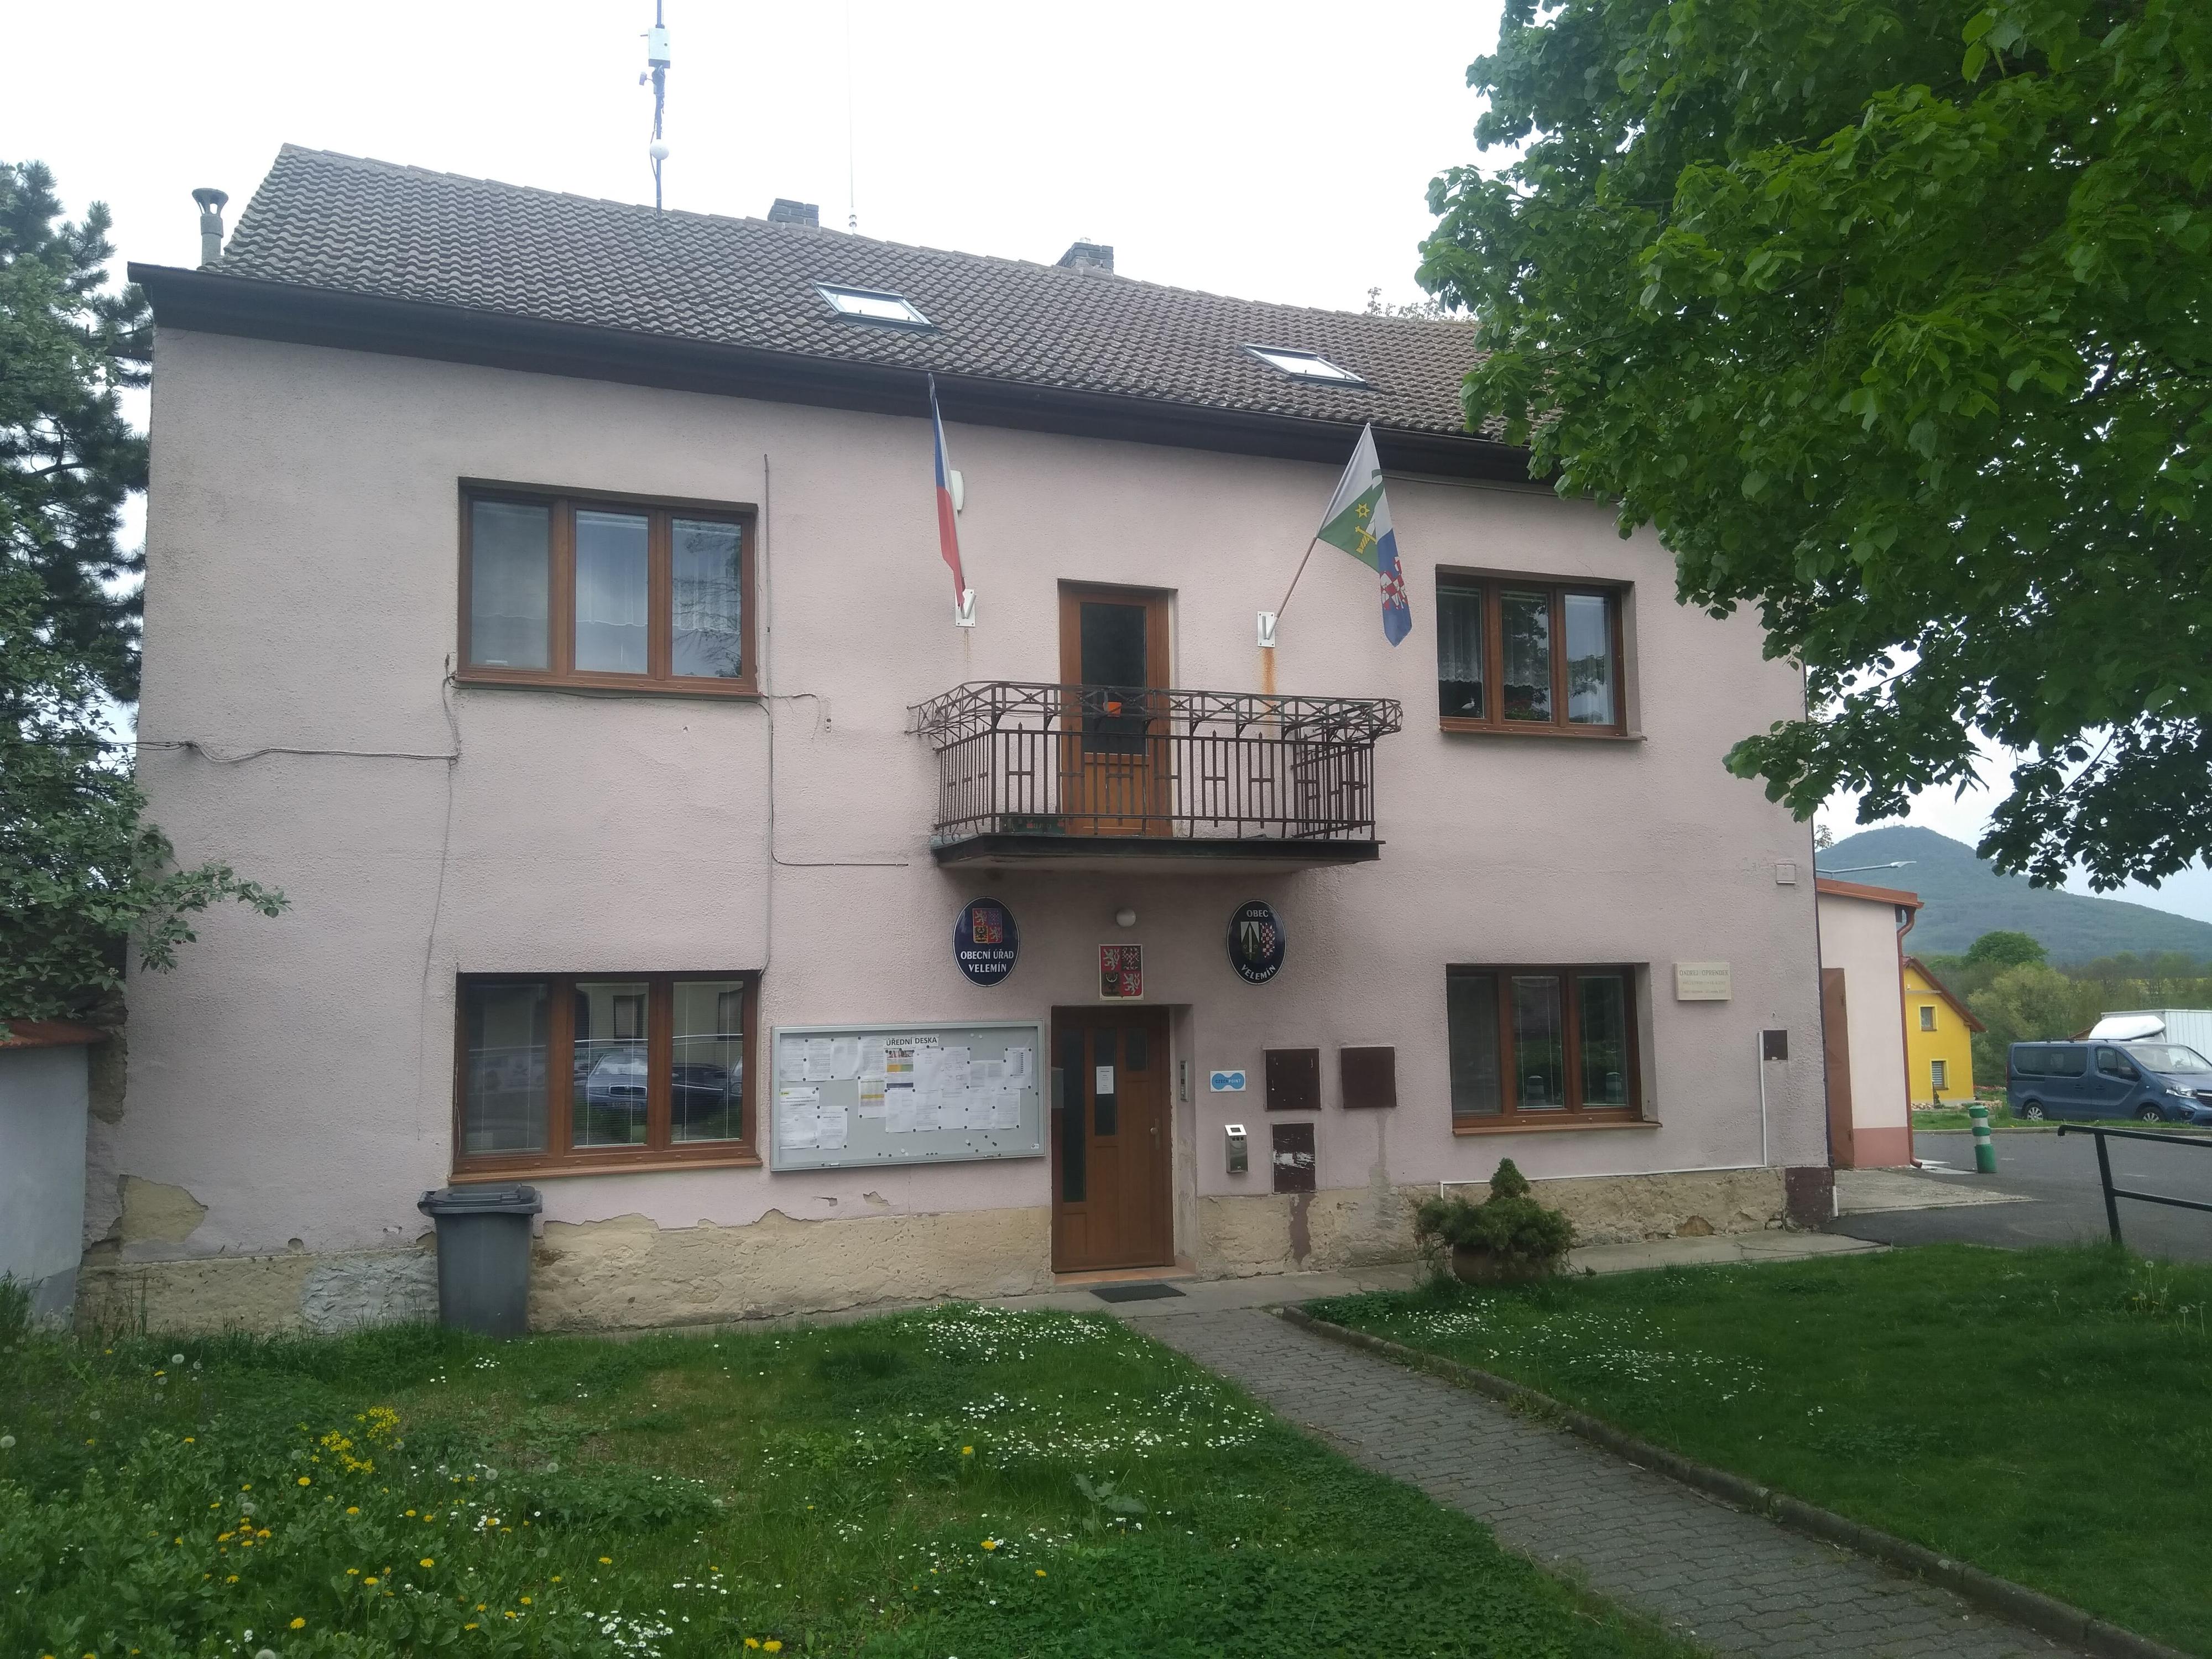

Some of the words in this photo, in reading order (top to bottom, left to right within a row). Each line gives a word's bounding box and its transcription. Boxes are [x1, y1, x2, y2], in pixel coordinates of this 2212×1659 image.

[960, 948, 991, 960] OBECNÍ
[993, 948, 1014, 959] ÚŘAD
[968, 961, 1006, 973] VELEMÍN
[1240, 964, 1276, 980] VELEMÍN
[886, 1037, 913, 1046] ÚŘEDNÍ
